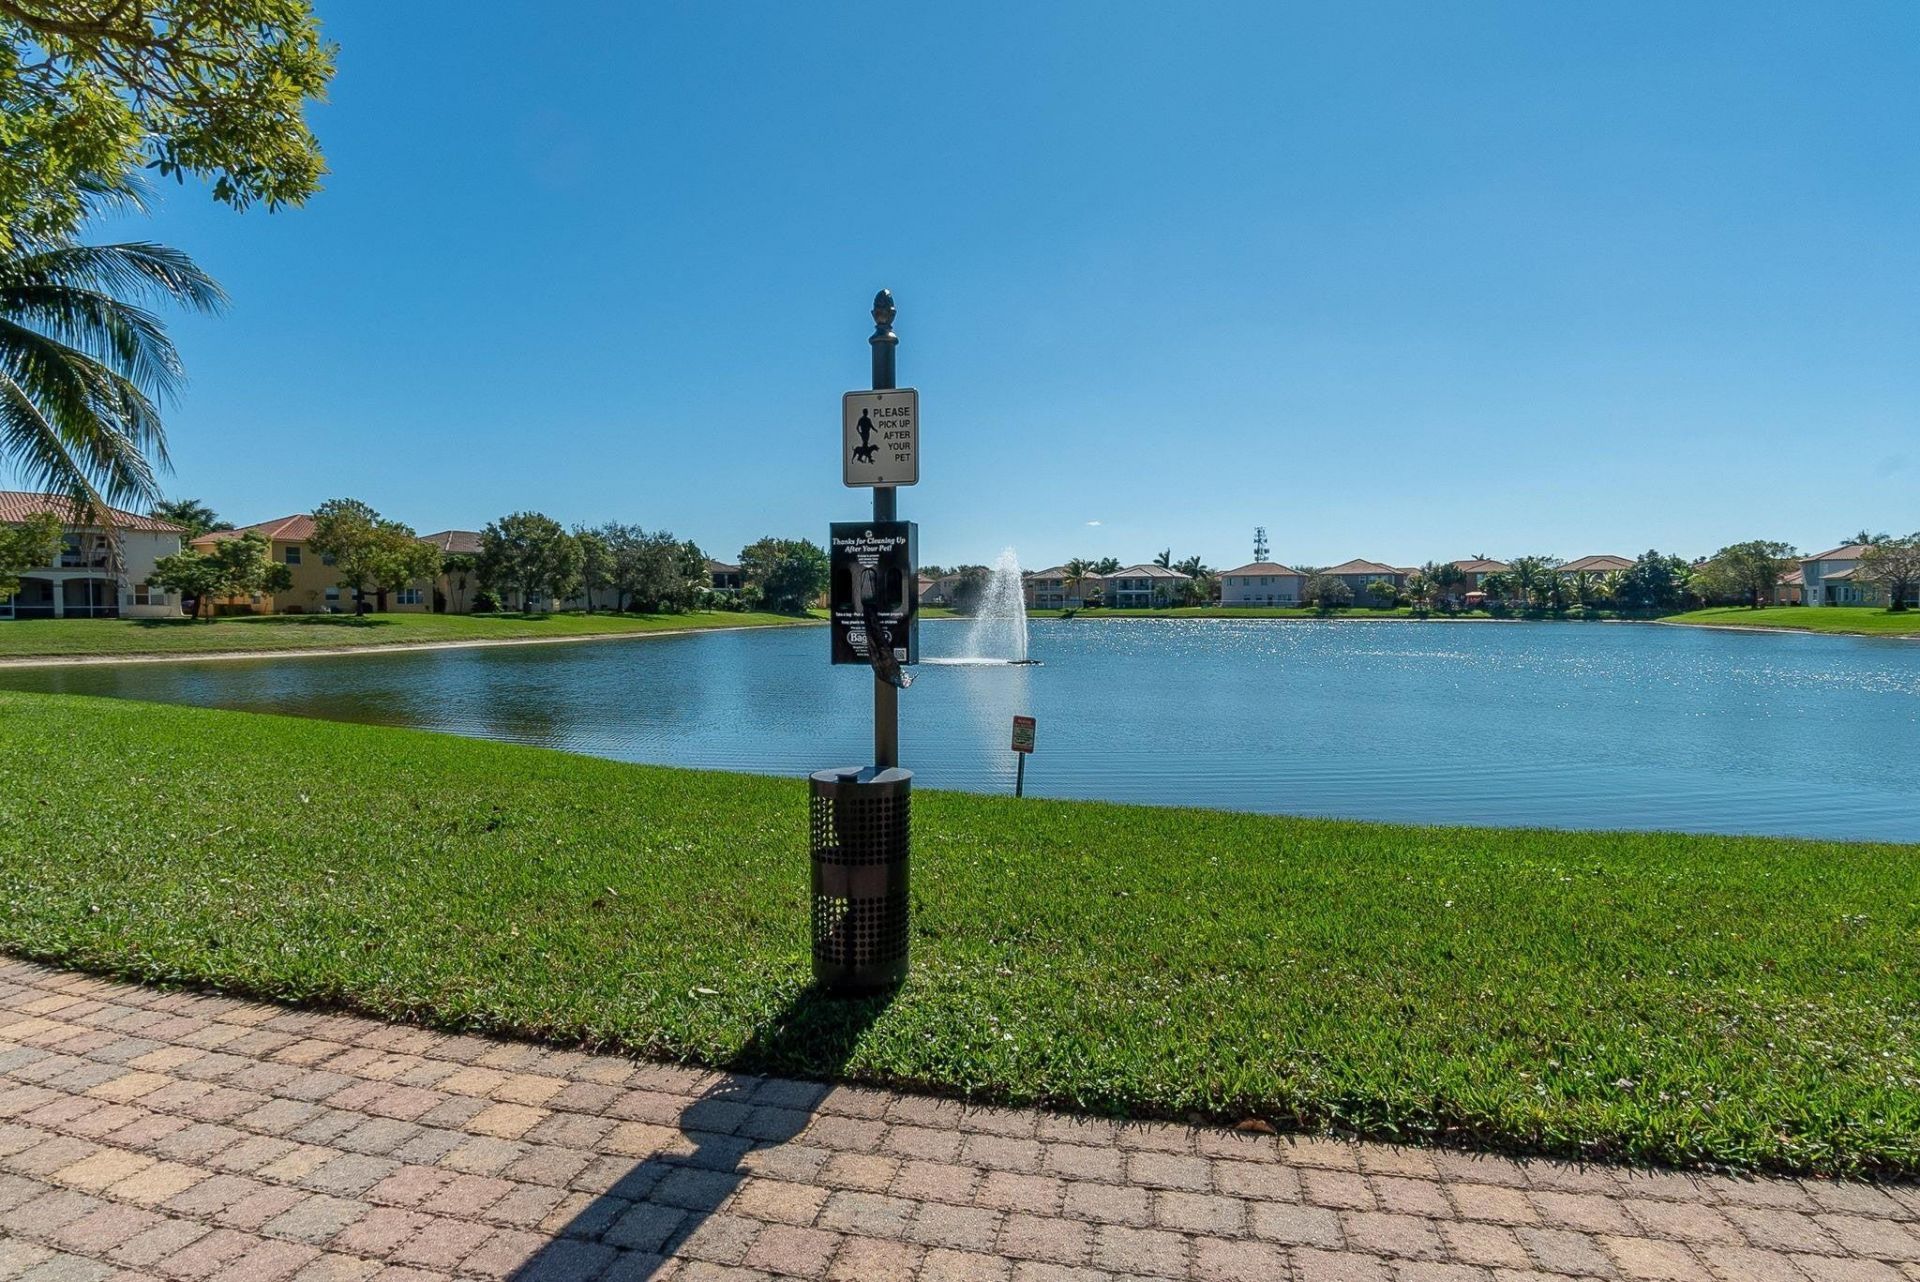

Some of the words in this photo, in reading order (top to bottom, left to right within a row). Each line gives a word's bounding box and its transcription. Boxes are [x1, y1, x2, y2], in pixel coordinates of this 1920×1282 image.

[873, 407, 911, 417] PLEASE
[878, 420, 897, 429] PICK
[899, 419, 911, 428] UP
[883, 431, 911, 440] AFTER
[888, 442, 911, 451] YOUR
[895, 453, 911, 462] PET
[832, 537, 855, 546] Thanks
[855, 538, 866, 546] for
[866, 537, 895, 545] Cleaning
[896, 536, 906, 545] Up
[844, 545, 862, 554] After
[850, 632, 868, 644] Bag
